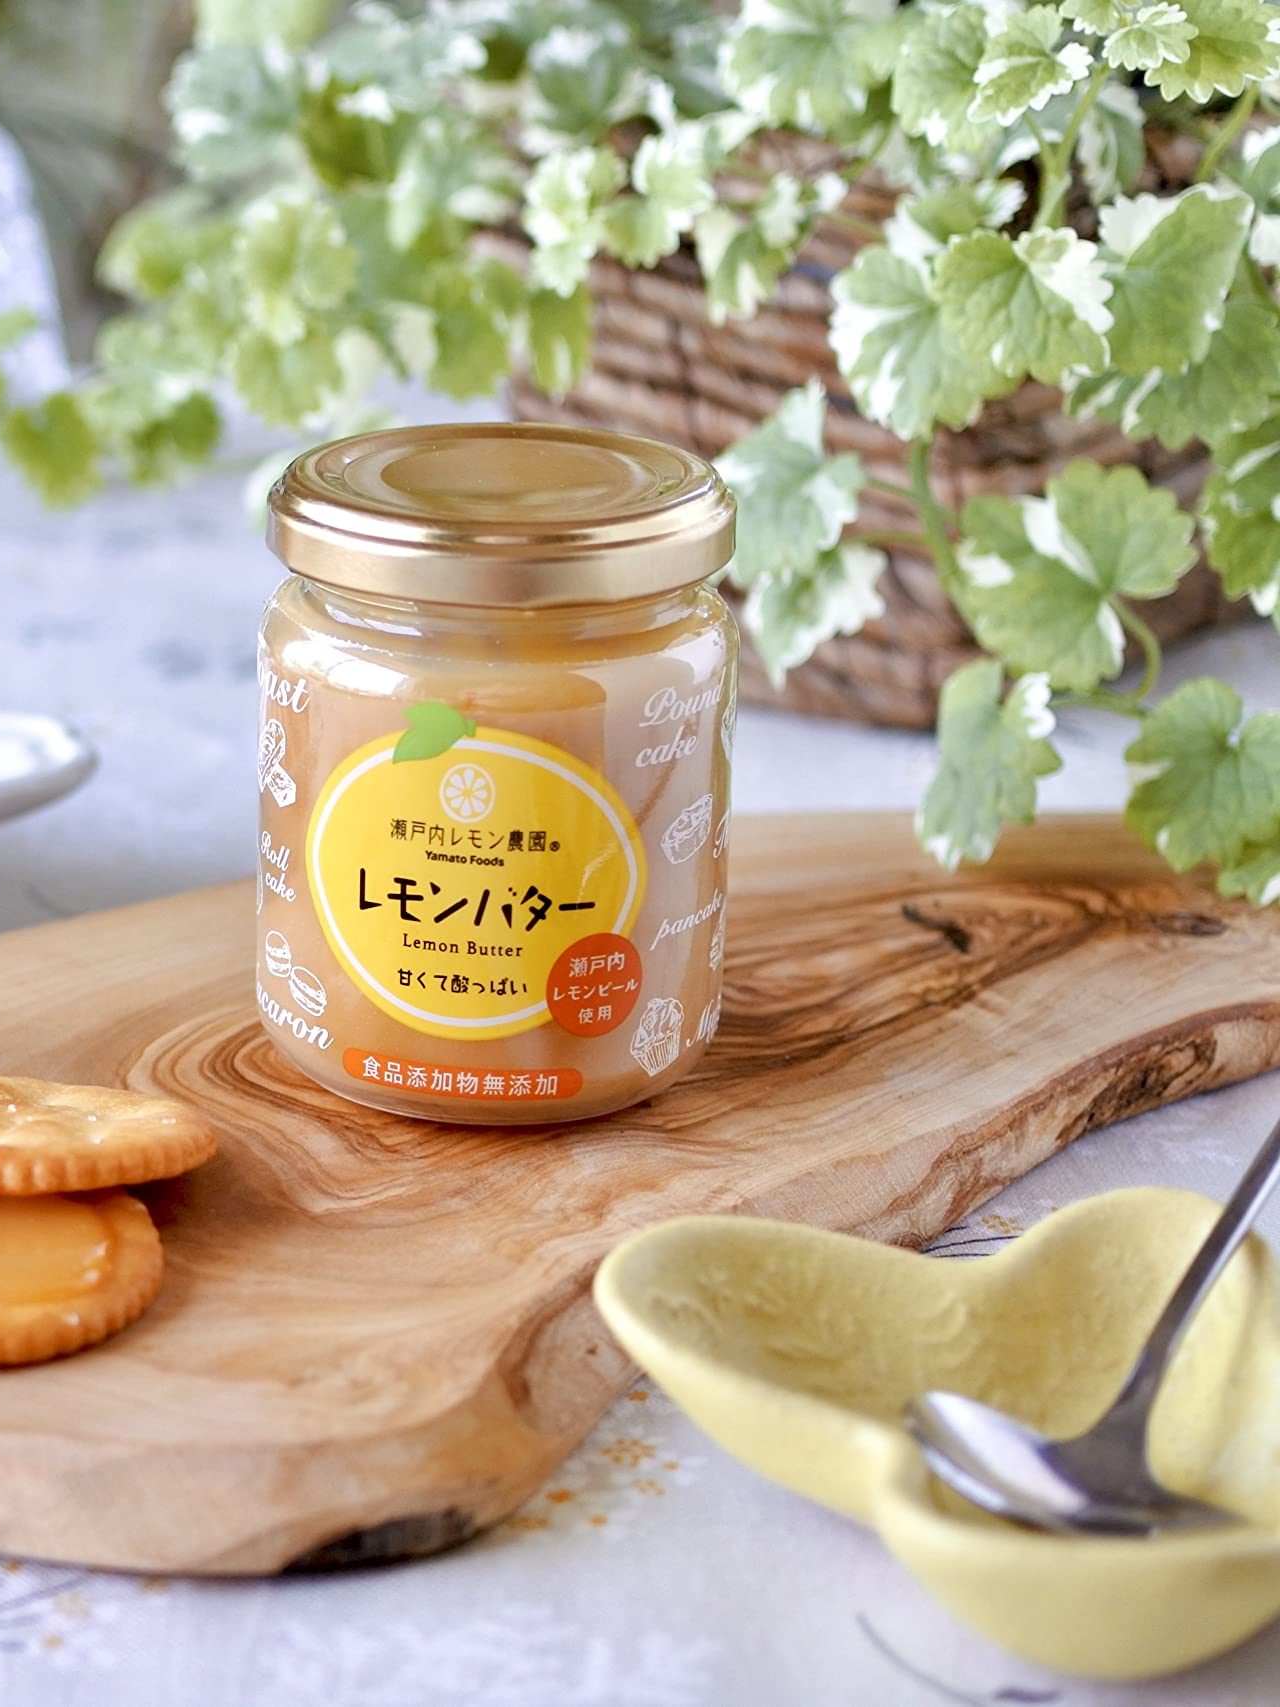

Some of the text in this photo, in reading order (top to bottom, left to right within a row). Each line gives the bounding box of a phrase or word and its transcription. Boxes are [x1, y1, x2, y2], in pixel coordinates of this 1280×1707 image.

[635, 725, 697, 768] cake
[261, 830, 291, 872] Roll
[425, 850, 505, 867] Yamato Foods
[265, 872, 297, 902] cake
[359, 868, 596, 931] レモンバター
[403, 933, 523, 957] Lemon Butter
[568, 951, 625, 978] 瀬戸内
[397, 968, 527, 996] 甘くて酸っぱい
[553, 978, 639, 1001] レモンピール
[578, 1005, 612, 1024] 使用
[362, 1056, 558, 1096] 食品添加物無添加
